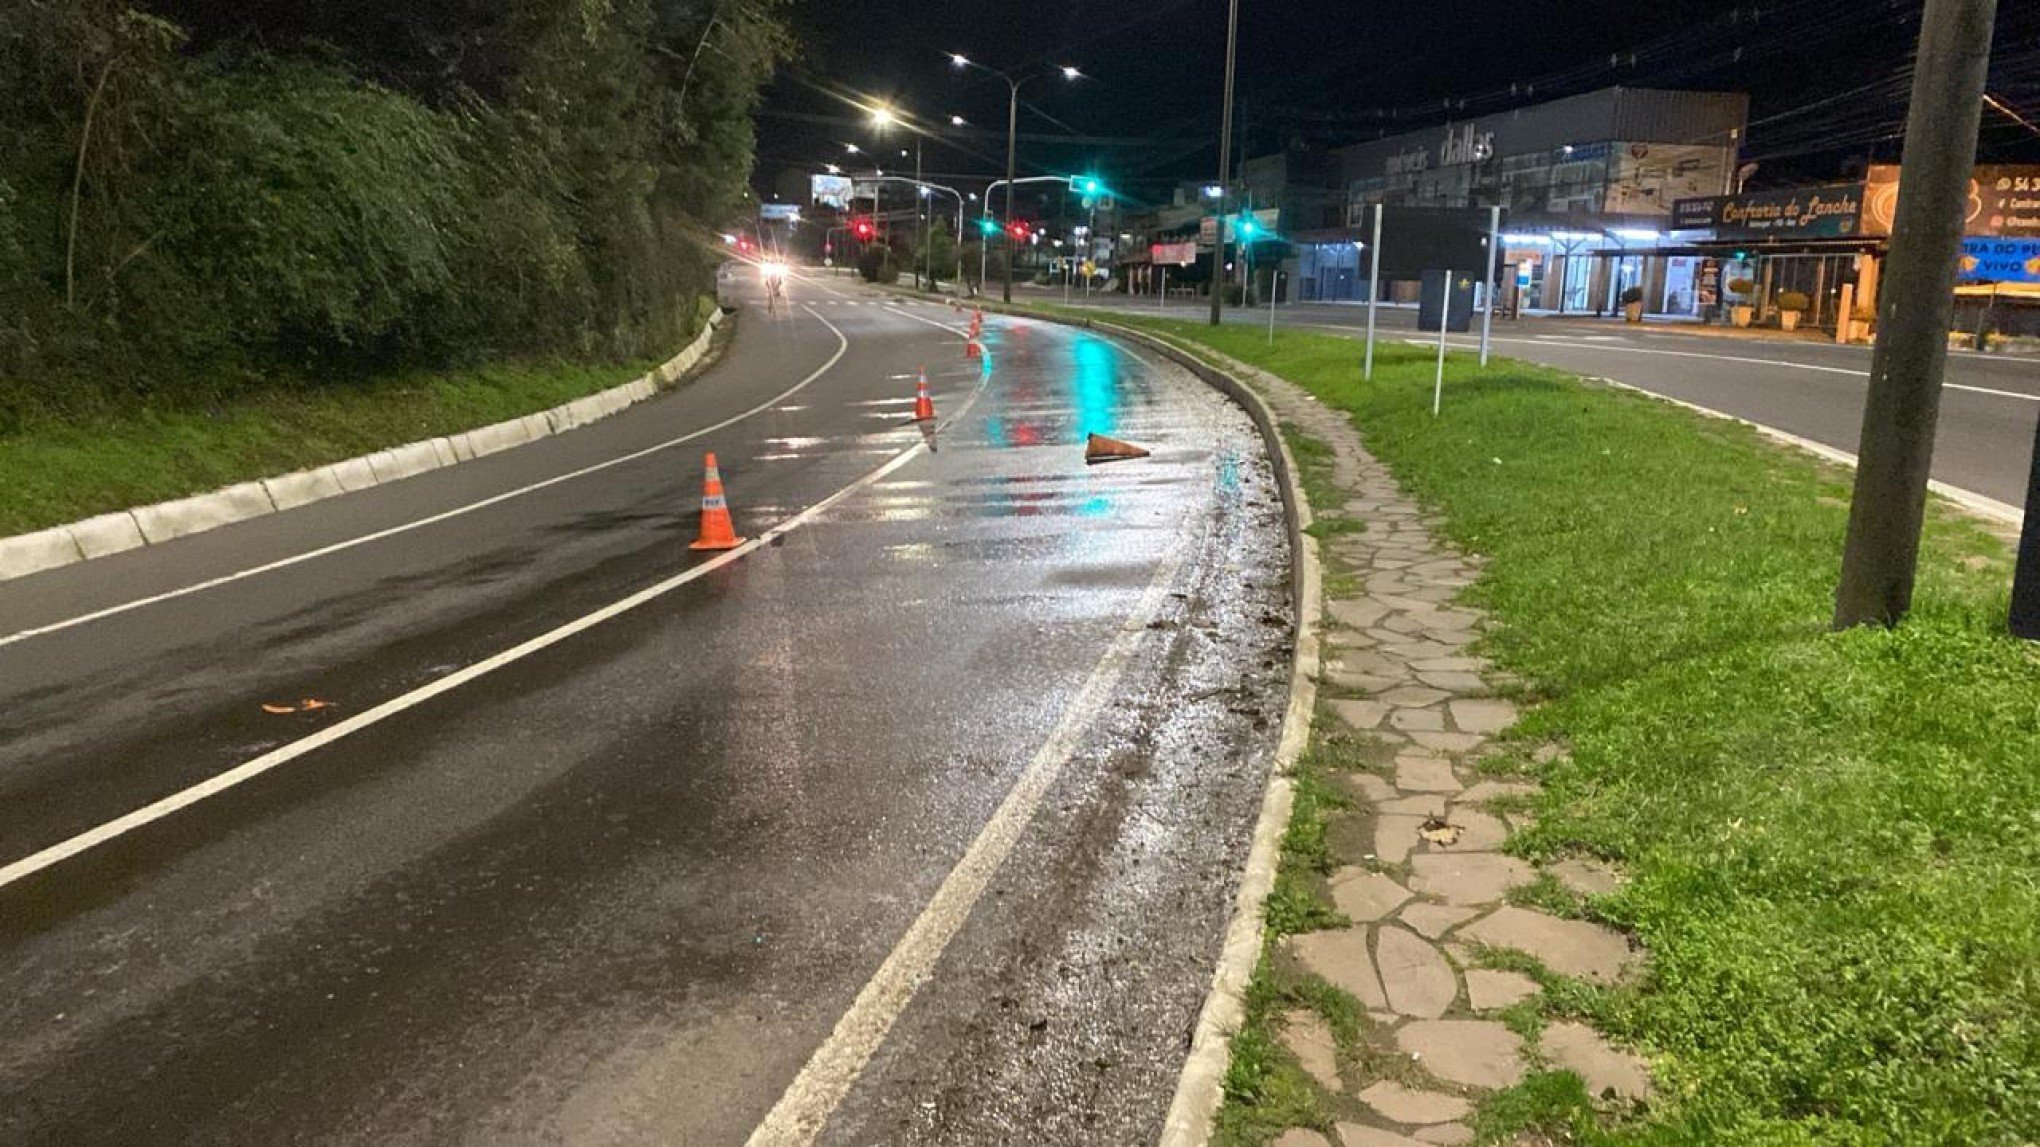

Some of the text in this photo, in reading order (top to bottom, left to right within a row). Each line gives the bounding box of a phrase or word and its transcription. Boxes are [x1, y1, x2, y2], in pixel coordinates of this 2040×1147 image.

[1441, 123, 1493, 165] dallas
[1800, 194, 1857, 226] Lanche
[1985, 261, 2021, 272] VIVO
